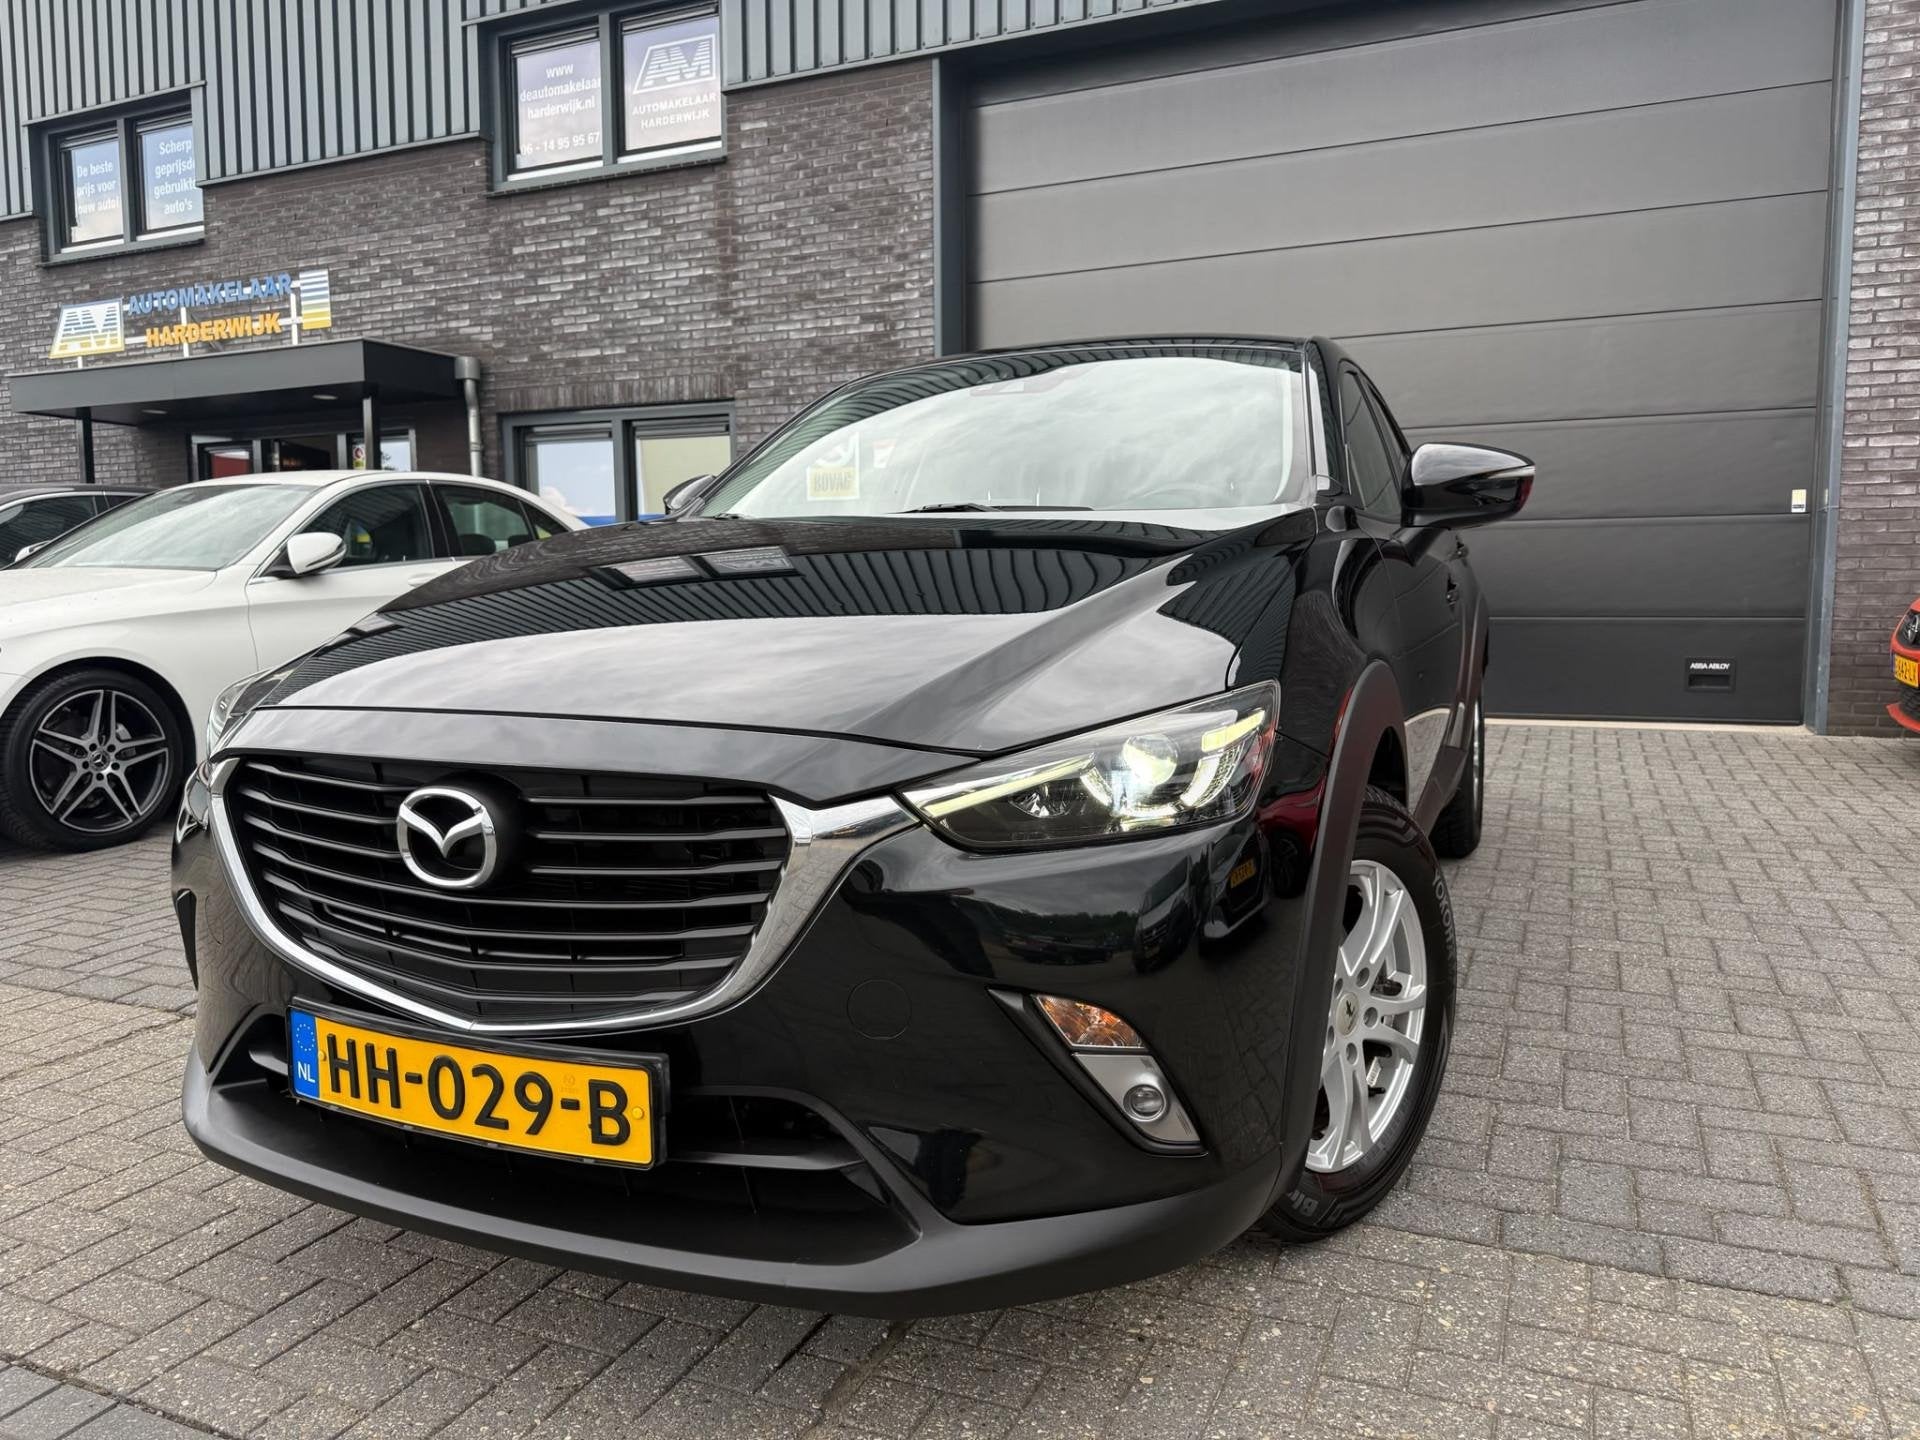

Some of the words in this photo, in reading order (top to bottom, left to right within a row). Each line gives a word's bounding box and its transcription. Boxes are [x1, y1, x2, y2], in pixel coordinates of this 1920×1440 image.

[546, 63, 574, 78] www
[527, 95, 595, 120] harderwijk.nl
[632, 92, 717, 115] AUTOMAKELAAR
[640, 108, 710, 128] HARDERWIJK
[159, 139, 192, 155] Scherp
[543, 139, 555, 152] 14
[557, 137, 570, 150] 95
[572, 134, 585, 147] 95
[587, 132, 600, 145] 67
[76, 165, 88, 178] De
[90, 160, 113, 175] beste
[96, 180, 116, 193] voor
[164, 198, 193, 215] auto's
[128, 273, 293, 316] AUTOMAKELAAR
[145, 312, 282, 348] HARDERWIJK
[1690, 662, 1707, 670] ASSA
[1708, 662, 1730, 670] ABLOY
[297, 1061, 316, 1084] NL
[326, 1033, 632, 1147] HH-029-B
